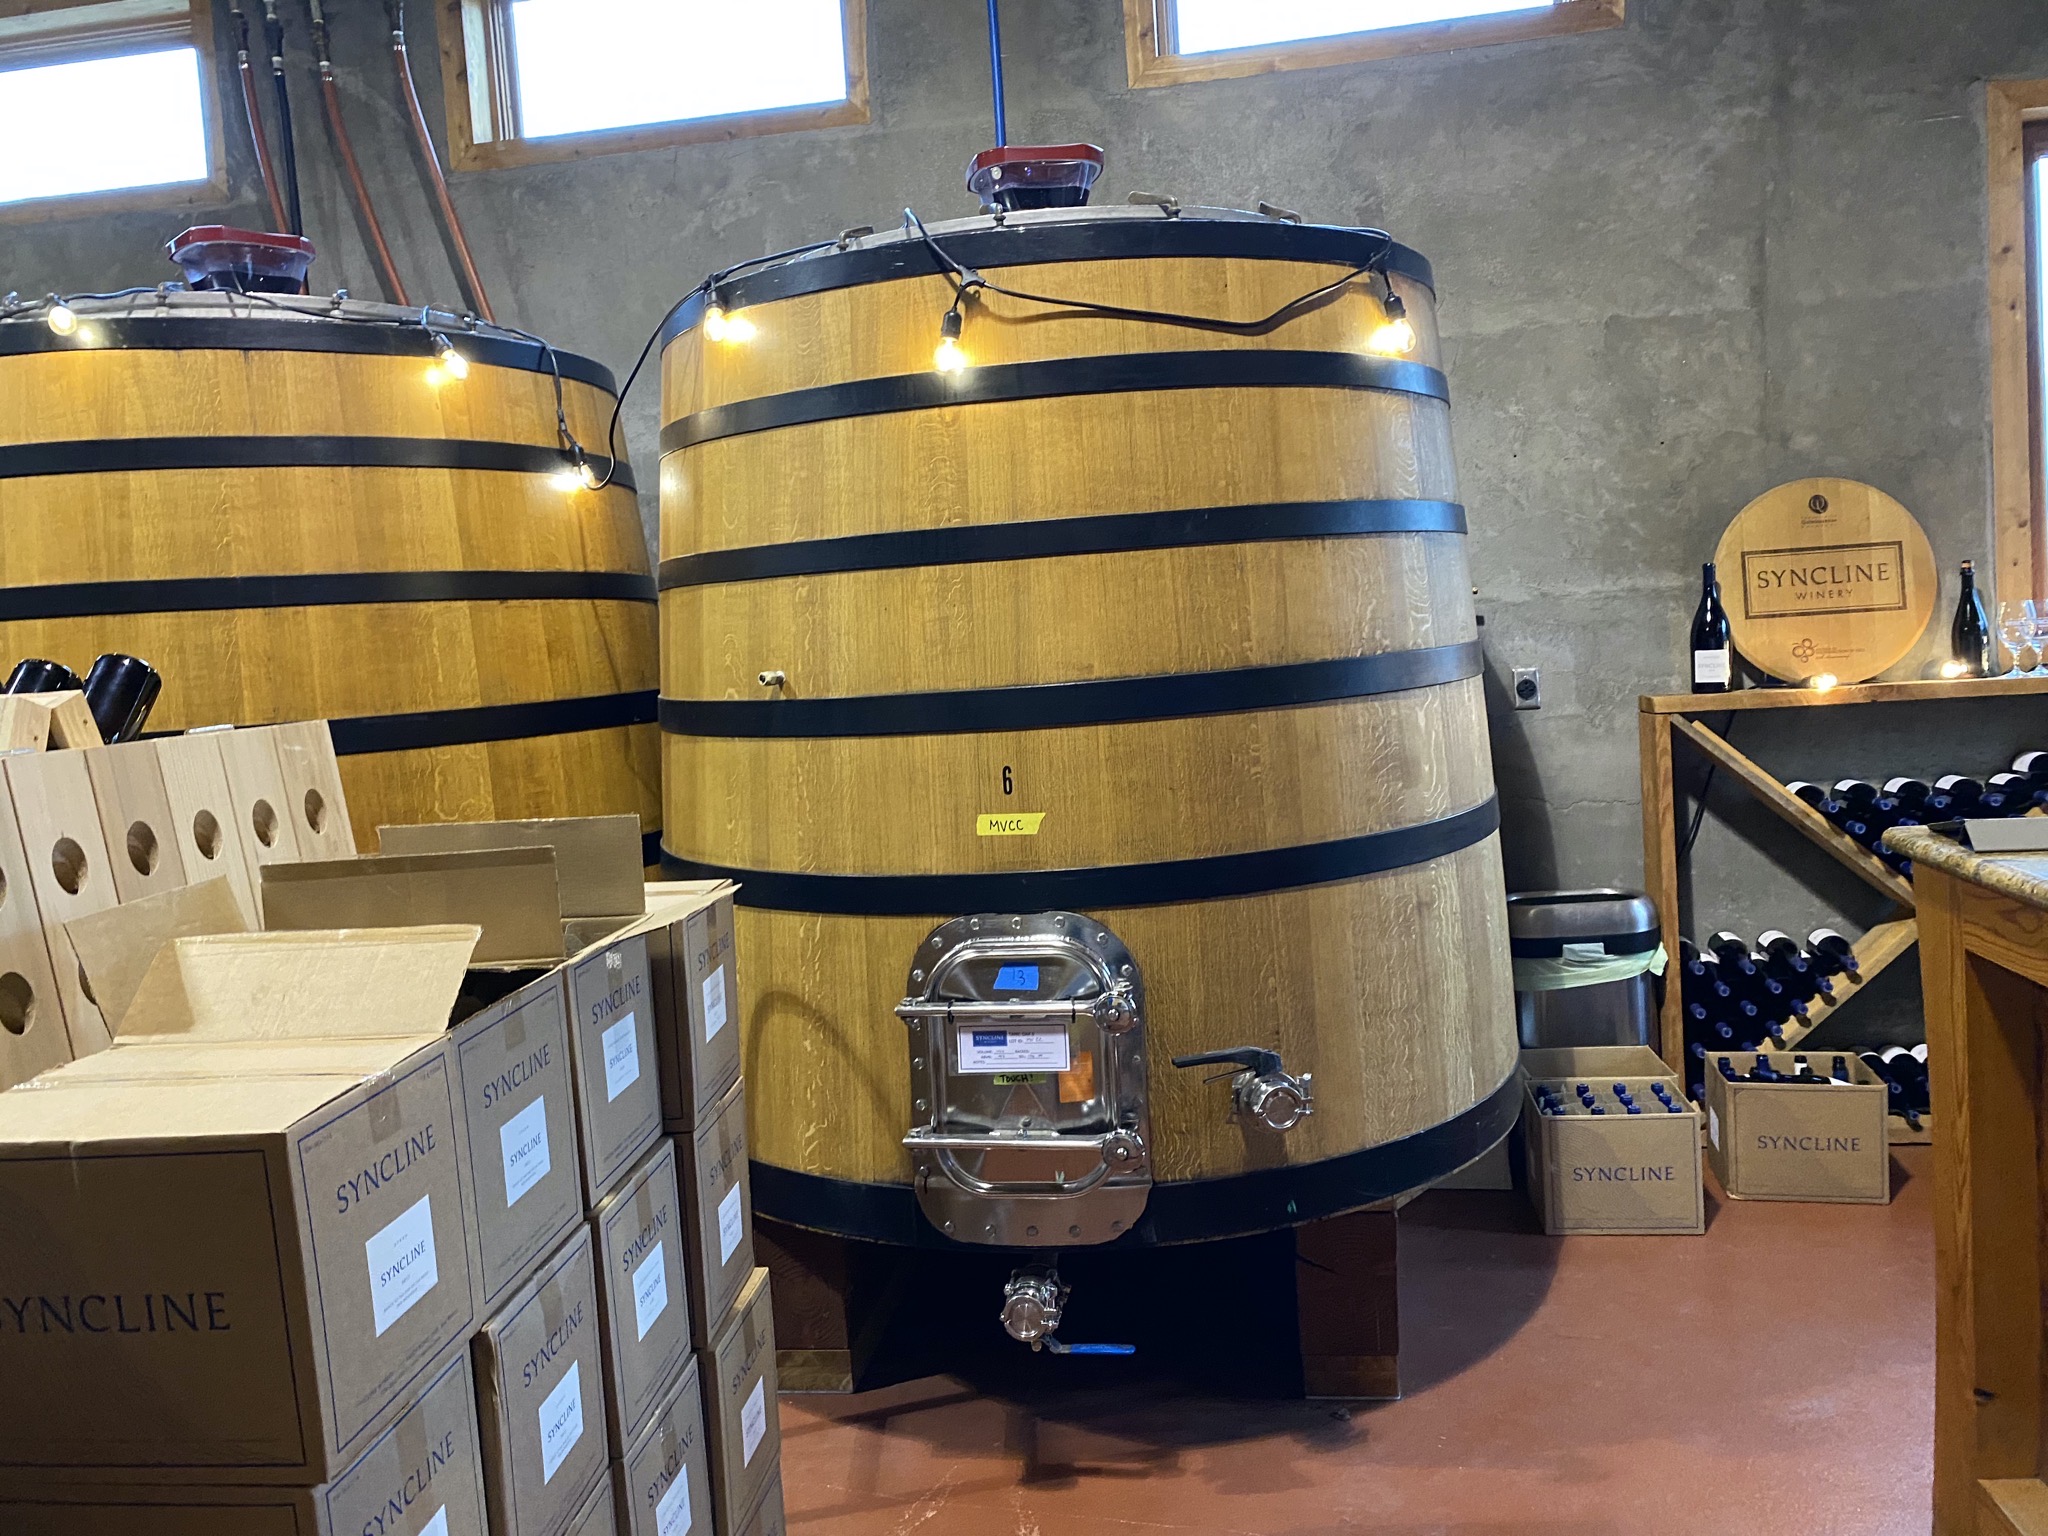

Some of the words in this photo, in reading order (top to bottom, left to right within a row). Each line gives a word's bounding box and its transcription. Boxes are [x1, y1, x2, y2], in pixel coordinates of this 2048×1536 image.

[1757, 563, 1890, 588] SYNCLINE
[1795, 589, 1854, 600] WINERY
[1002, 766, 1012, 795] 6
[989, 819, 1024, 832] MVCC
[698, 932, 730, 971] SYNCLINE
[592, 975, 641, 1025] SYNCLINE
[609, 1043, 634, 1069] SYNCLINE
[483, 1044, 551, 1109] SYNCLINE
[510, 1132, 542, 1167] SYNCLINE
[710, 1133, 743, 1186] SYNCLINE
[1757, 1136, 1861, 1151] SYNCLINE
[337, 1124, 436, 1214] SYNCLINE
[1573, 1167, 1675, 1182] SYNCLINE
[623, 1204, 668, 1272] SYNCLINE
[380, 1240, 426, 1287] SYNCLINE
[639, 1273, 662, 1307] SYNCLINE
[0, 1292, 231, 1333] YNCLINE
[523, 1301, 584, 1388] SYNCLINE
[546, 1398, 577, 1443] SYNCLINE
[648, 1424, 694, 1508] SYNCLINE
